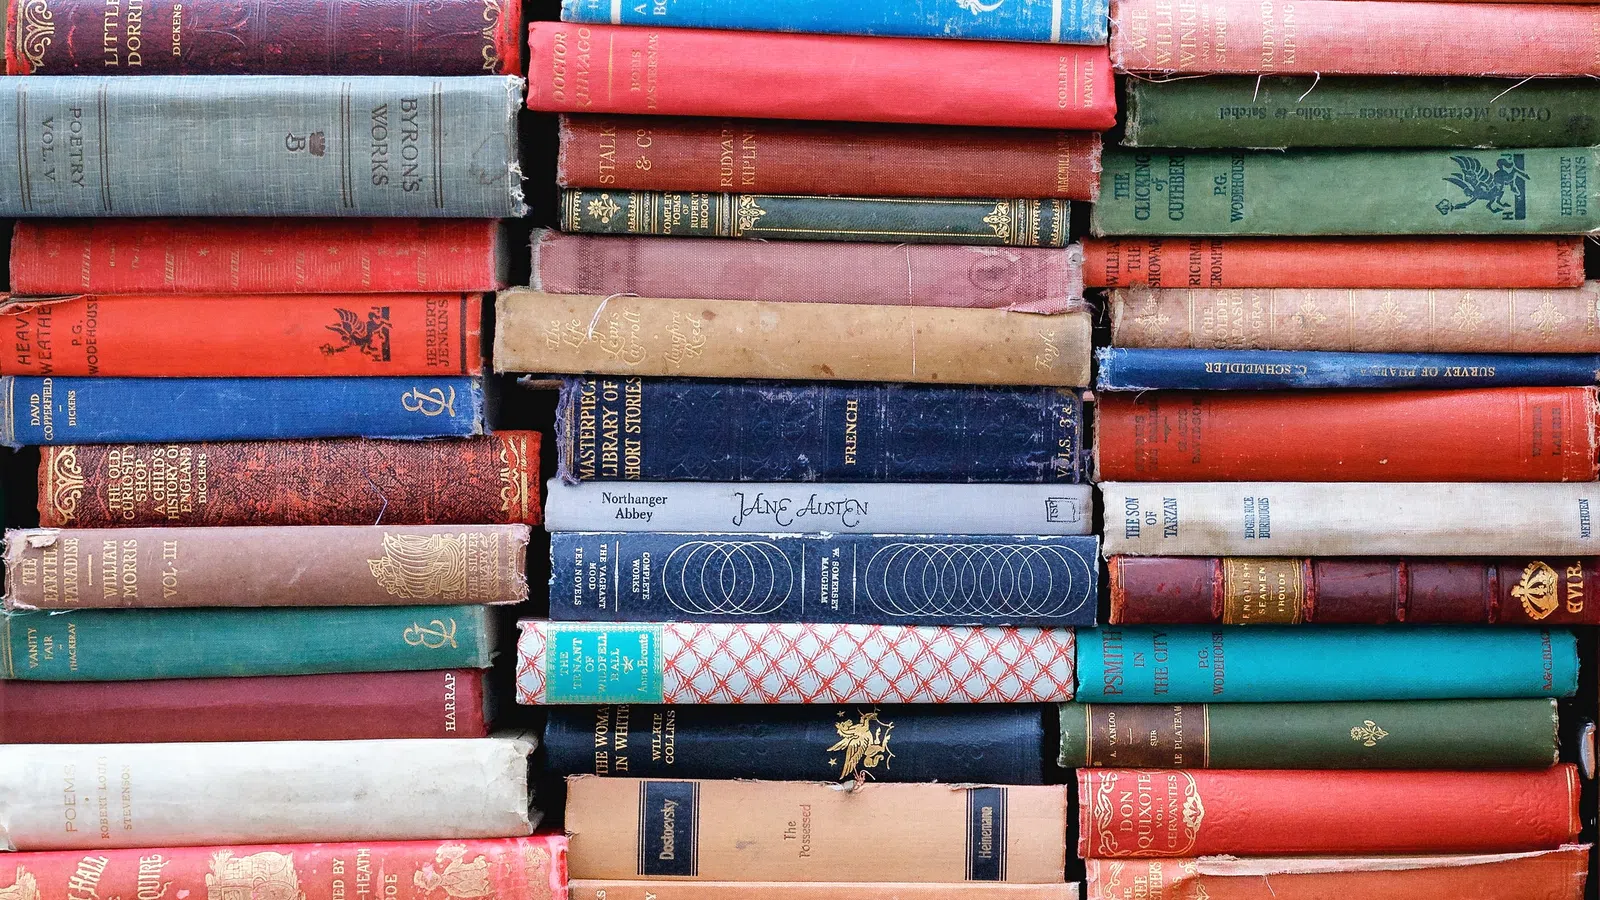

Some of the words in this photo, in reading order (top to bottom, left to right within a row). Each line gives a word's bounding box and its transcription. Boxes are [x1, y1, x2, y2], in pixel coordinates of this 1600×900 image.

[104, 0, 120, 66] LITTLE
[172, 4, 182, 56] DICKENS
[1132, 9, 1148, 51] WEE
[1215, 4, 1227, 63] STORIES
[1261, 0, 1273, 69] RUDYARD
[1283, 4, 1295, 65] KIPLING
[553, 31, 568, 103] DOCTOR
[1059, 56, 1068, 109] COLLINS
[1084, 57, 1095, 108] HARVILL
[1219, 106, 1266, 120] Satchel
[1296, 107, 1332, 120] Rollo
[1498, 107, 1551, 122] Ovid's
[69, 107, 84, 188] POETRY
[371, 103, 389, 186] WORKS
[401, 98, 420, 192] BYRON'S
[636, 155, 651, 171] &
[1114, 173, 1130, 200] THE
[1135, 153, 1150, 221] CLICKING
[1153, 177, 1168, 192] of
[1168, 154, 1185, 221] CUTHBER
[1560, 156, 1573, 216] HERBERT
[1575, 156, 1587, 216] JENKINS
[673, 194, 681, 225] POEMS
[682, 203, 689, 215] OF
[690, 193, 699, 229] RUPERT
[1128, 246, 1141, 273] THE
[37, 305, 53, 375] WEATHE
[86, 295, 99, 375] WODEHOUSE
[426, 298, 437, 367] HERBERT
[437, 299, 450, 367] JENKINS
[543, 320, 560, 351] The
[599, 312, 626, 360] Lewis
[622, 307, 647, 366] Carroll
[1204, 362, 1291, 375] SCHMEIDLER
[1421, 366, 1439, 377] OF
[1444, 366, 1495, 377] SURVEY
[31, 393, 40, 426] DAVID
[43, 377, 53, 441] COPPERFIELD
[68, 390, 76, 426] DICKENS
[602, 380, 619, 402] OF
[625, 377, 642, 434] STORIES
[602, 406, 619, 477] LIBRARY
[845, 399, 858, 465] FRENCH
[108, 450, 121, 478] OLD
[135, 458, 148, 502] SHOP
[150, 447, 166, 501] CHILD'S
[180, 446, 192, 513] ENGLAND
[198, 453, 207, 504] DICKENS
[624, 438, 641, 480] SHORT
[108, 485, 121, 511] THE
[122, 444, 135, 520] CURIOSITY
[167, 464, 180, 520] HISTORY
[602, 492, 668, 508] Northanger
[154, 505, 166, 515] A
[615, 507, 653, 522] Abbey
[1125, 497, 1139, 517] SON
[1126, 517, 1140, 540] THE
[1146, 511, 1157, 526] OF
[1163, 497, 1177, 538] TARZAN
[1258, 497, 1270, 539] BURROUGHS
[1578, 498, 1590, 539] METHUEN
[23, 558, 38, 585] THE
[64, 537, 79, 603] PARADISE
[103, 539, 117, 599] WILLIAM
[123, 539, 138, 598] MORRIS
[468, 532, 479, 572] SILVER
[575, 547, 583, 566] TEN
[468, 575, 479, 599] THE
[574, 568, 583, 606] NOVELS
[588, 562, 596, 590] MOOD
[599, 565, 607, 609] VAGRANT
[632, 559, 640, 593] WORKS
[642, 551, 650, 600] COMPLETE
[821, 557, 829, 604] MAUGHAM
[831, 560, 840, 611] SOMERSET
[1242, 562, 1250, 619] ENGLISH
[1258, 566, 1267, 615] SEAMEN
[28, 627, 38, 669] VANITY
[44, 635, 54, 660] FAIR
[68, 622, 78, 671] THACKERAY
[560, 651, 568, 676] THE
[573, 637, 583, 690] TENANT
[585, 656, 594, 673] OF
[1102, 628, 1124, 697] PSMITH
[1133, 651, 1145, 668] IN
[1153, 630, 1168, 663] CITY
[1212, 629, 1224, 697] WODEHOUSE
[445, 672, 456, 732] HARRAP
[637, 668, 648, 693] Anne
[1154, 666, 1169, 696] THE
[595, 705, 610, 749] WOMA
[652, 713, 662, 761] WILKIE
[665, 710, 676, 765] COLLINS
[1150, 729, 1158, 747] SUR
[595, 751, 609, 776] THE
[616, 756, 628, 772] IN
[1175, 753, 1182, 765] LE
[64, 763, 78, 833] POEMS
[99, 796, 110, 840] ROBERT
[1120, 790, 1133, 832] DON
[1138, 773, 1155, 849] QUIXOTE
[1168, 775, 1178, 848] CERVANTES
[659, 798, 679, 860] Dostoevsky
[783, 820, 796, 841] The
[799, 804, 812, 859] Possessed
[978, 806, 993, 859] Heinemann
[333, 858, 345, 874] BY
